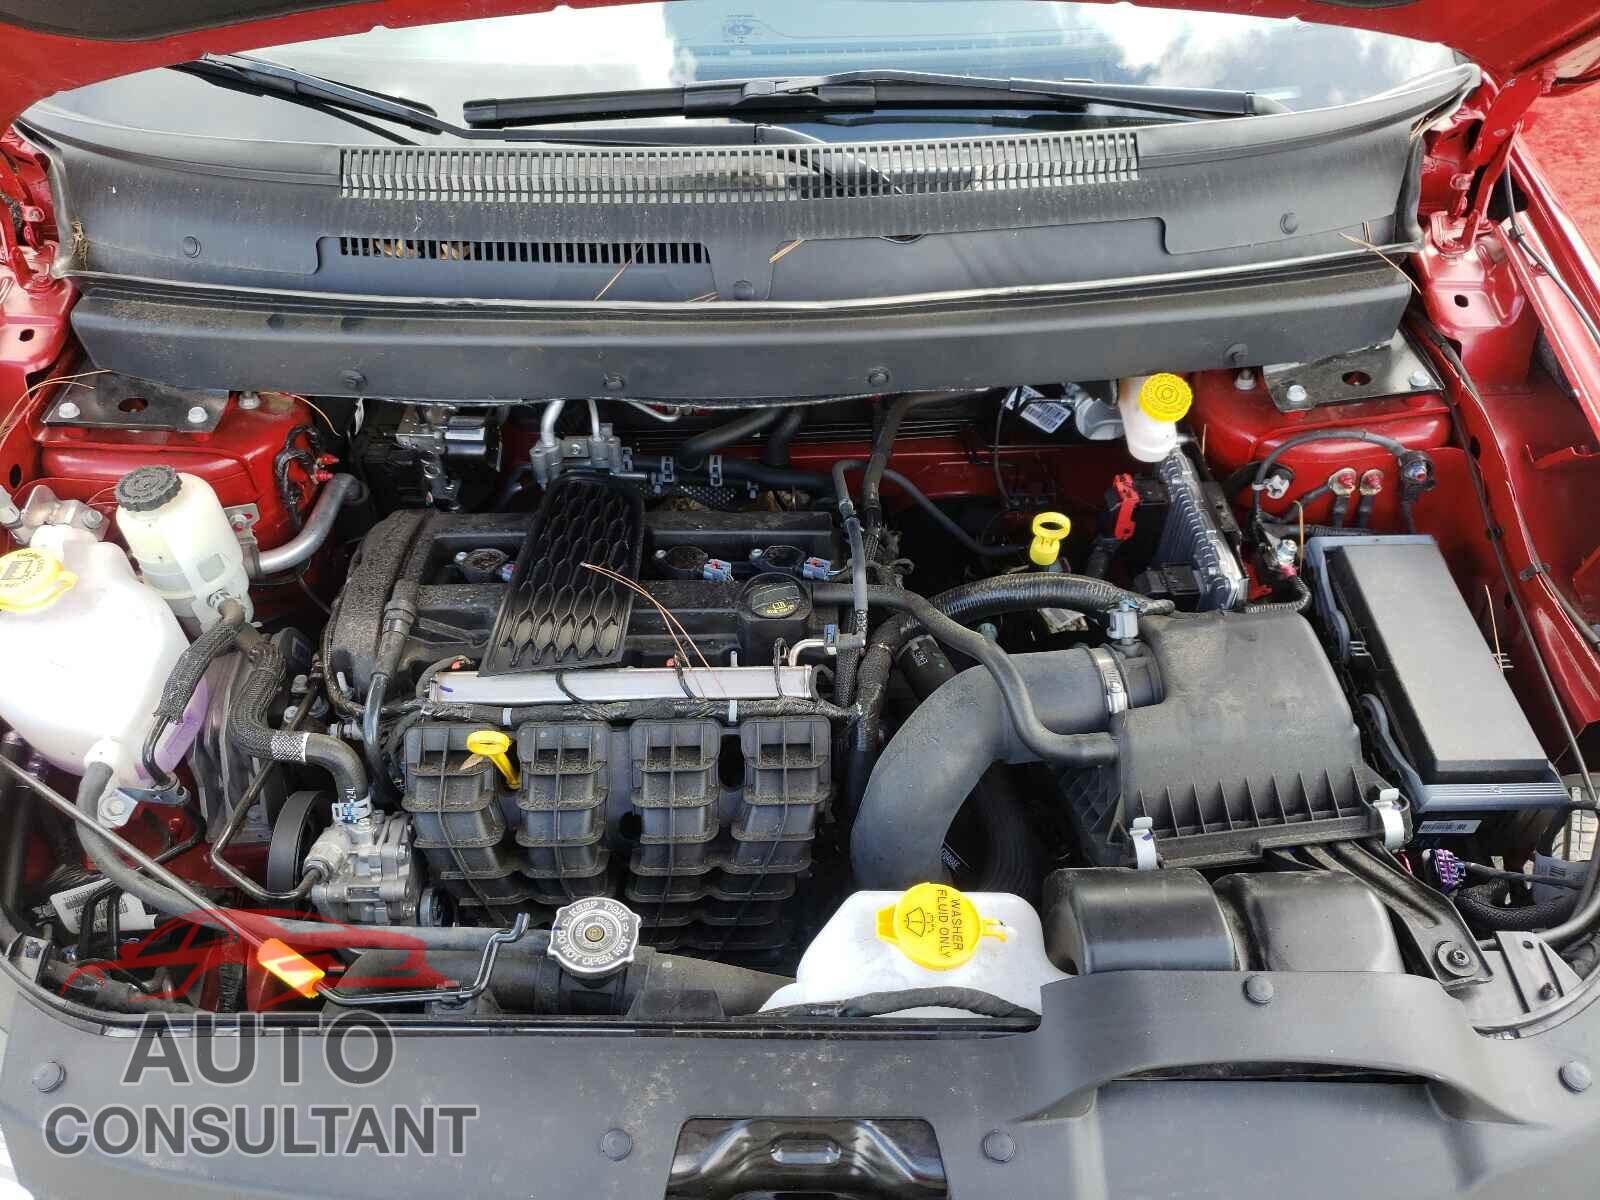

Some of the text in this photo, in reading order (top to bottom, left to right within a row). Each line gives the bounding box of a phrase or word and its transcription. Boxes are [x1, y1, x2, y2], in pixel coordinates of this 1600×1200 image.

[568, 900, 598, 917] KEEP
[936, 889, 952, 958] FLUID ONLY
[950, 898, 964, 951] WASHER
